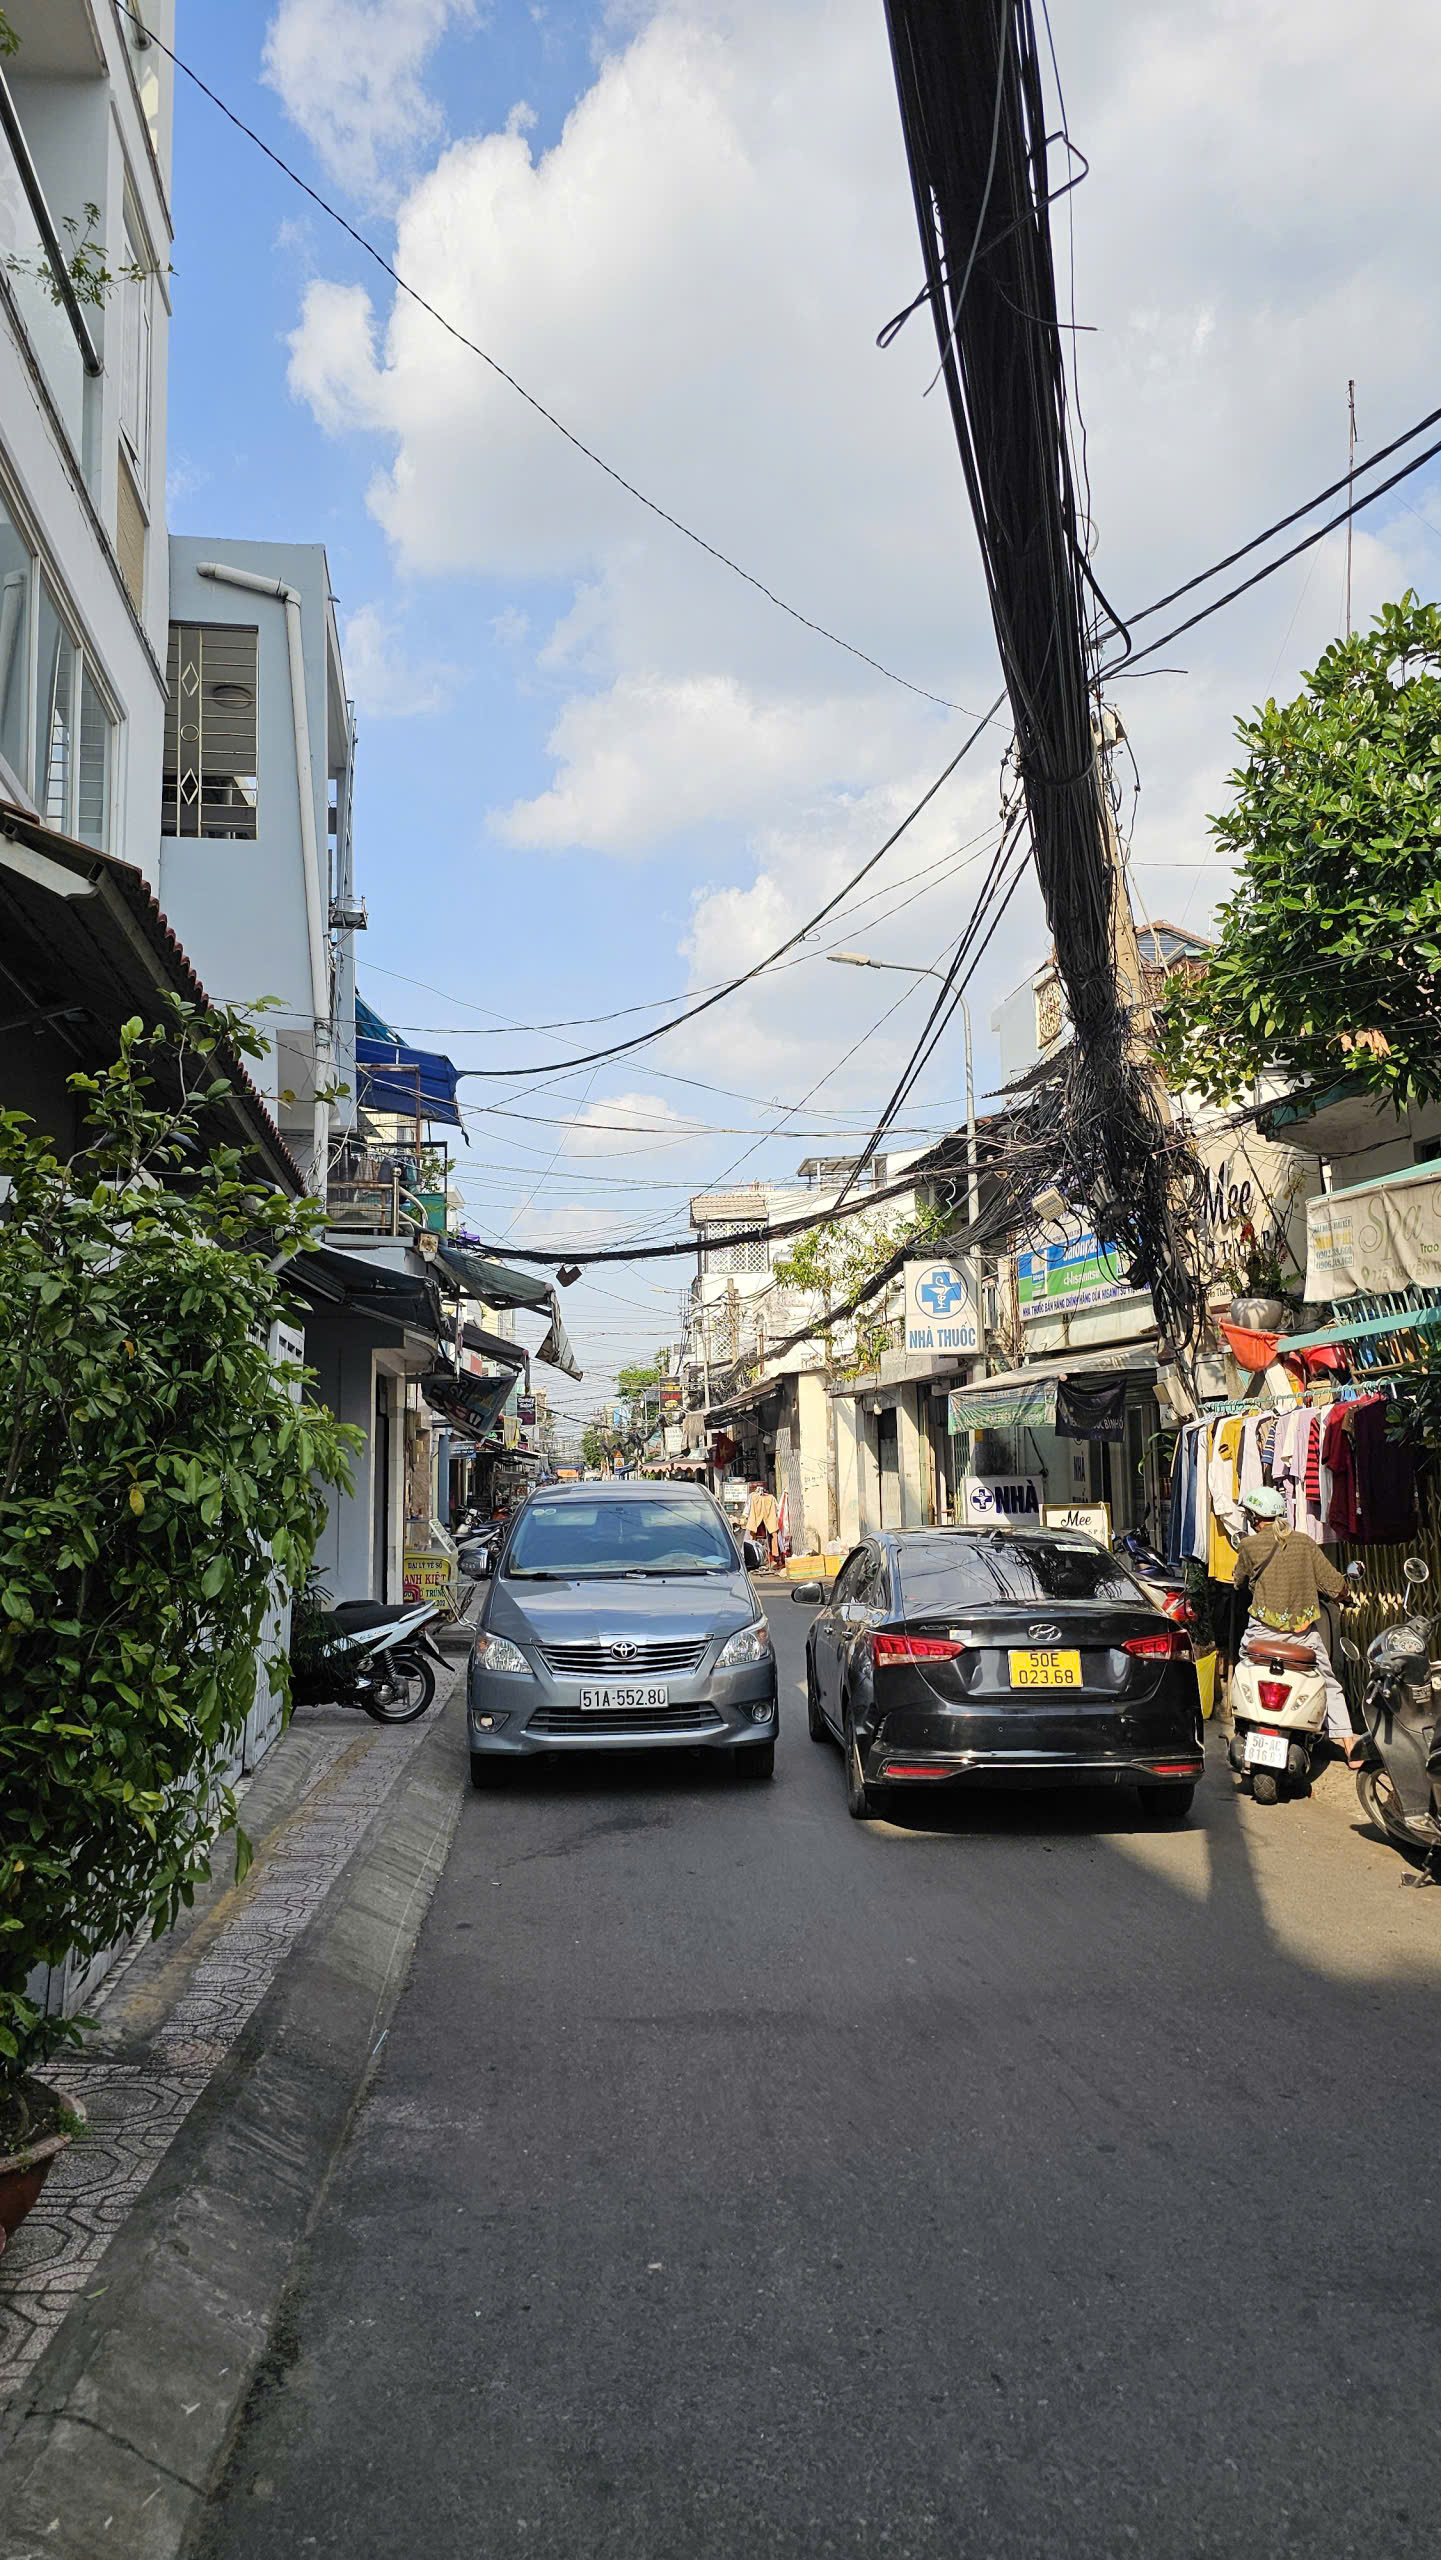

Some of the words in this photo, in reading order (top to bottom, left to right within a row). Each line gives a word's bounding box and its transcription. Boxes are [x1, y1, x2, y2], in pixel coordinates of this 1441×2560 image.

[1202, 1160, 1250, 1225] Mee
[1359, 1196, 1423, 1260] Spa
[909, 1326, 934, 1349] NHÀ
[937, 1321, 976, 1348] THUỐC
[994, 1479, 1039, 1514] NHÀ
[1061, 1510, 1092, 1527] Mee
[404, 1573, 422, 1585] ANH
[425, 1571, 447, 1586] KIỆT
[1030, 1652, 1060, 1667] 50E
[1019, 1669, 1074, 1684] 023.68
[583, 1688, 666, 1707] 51A-552.80
